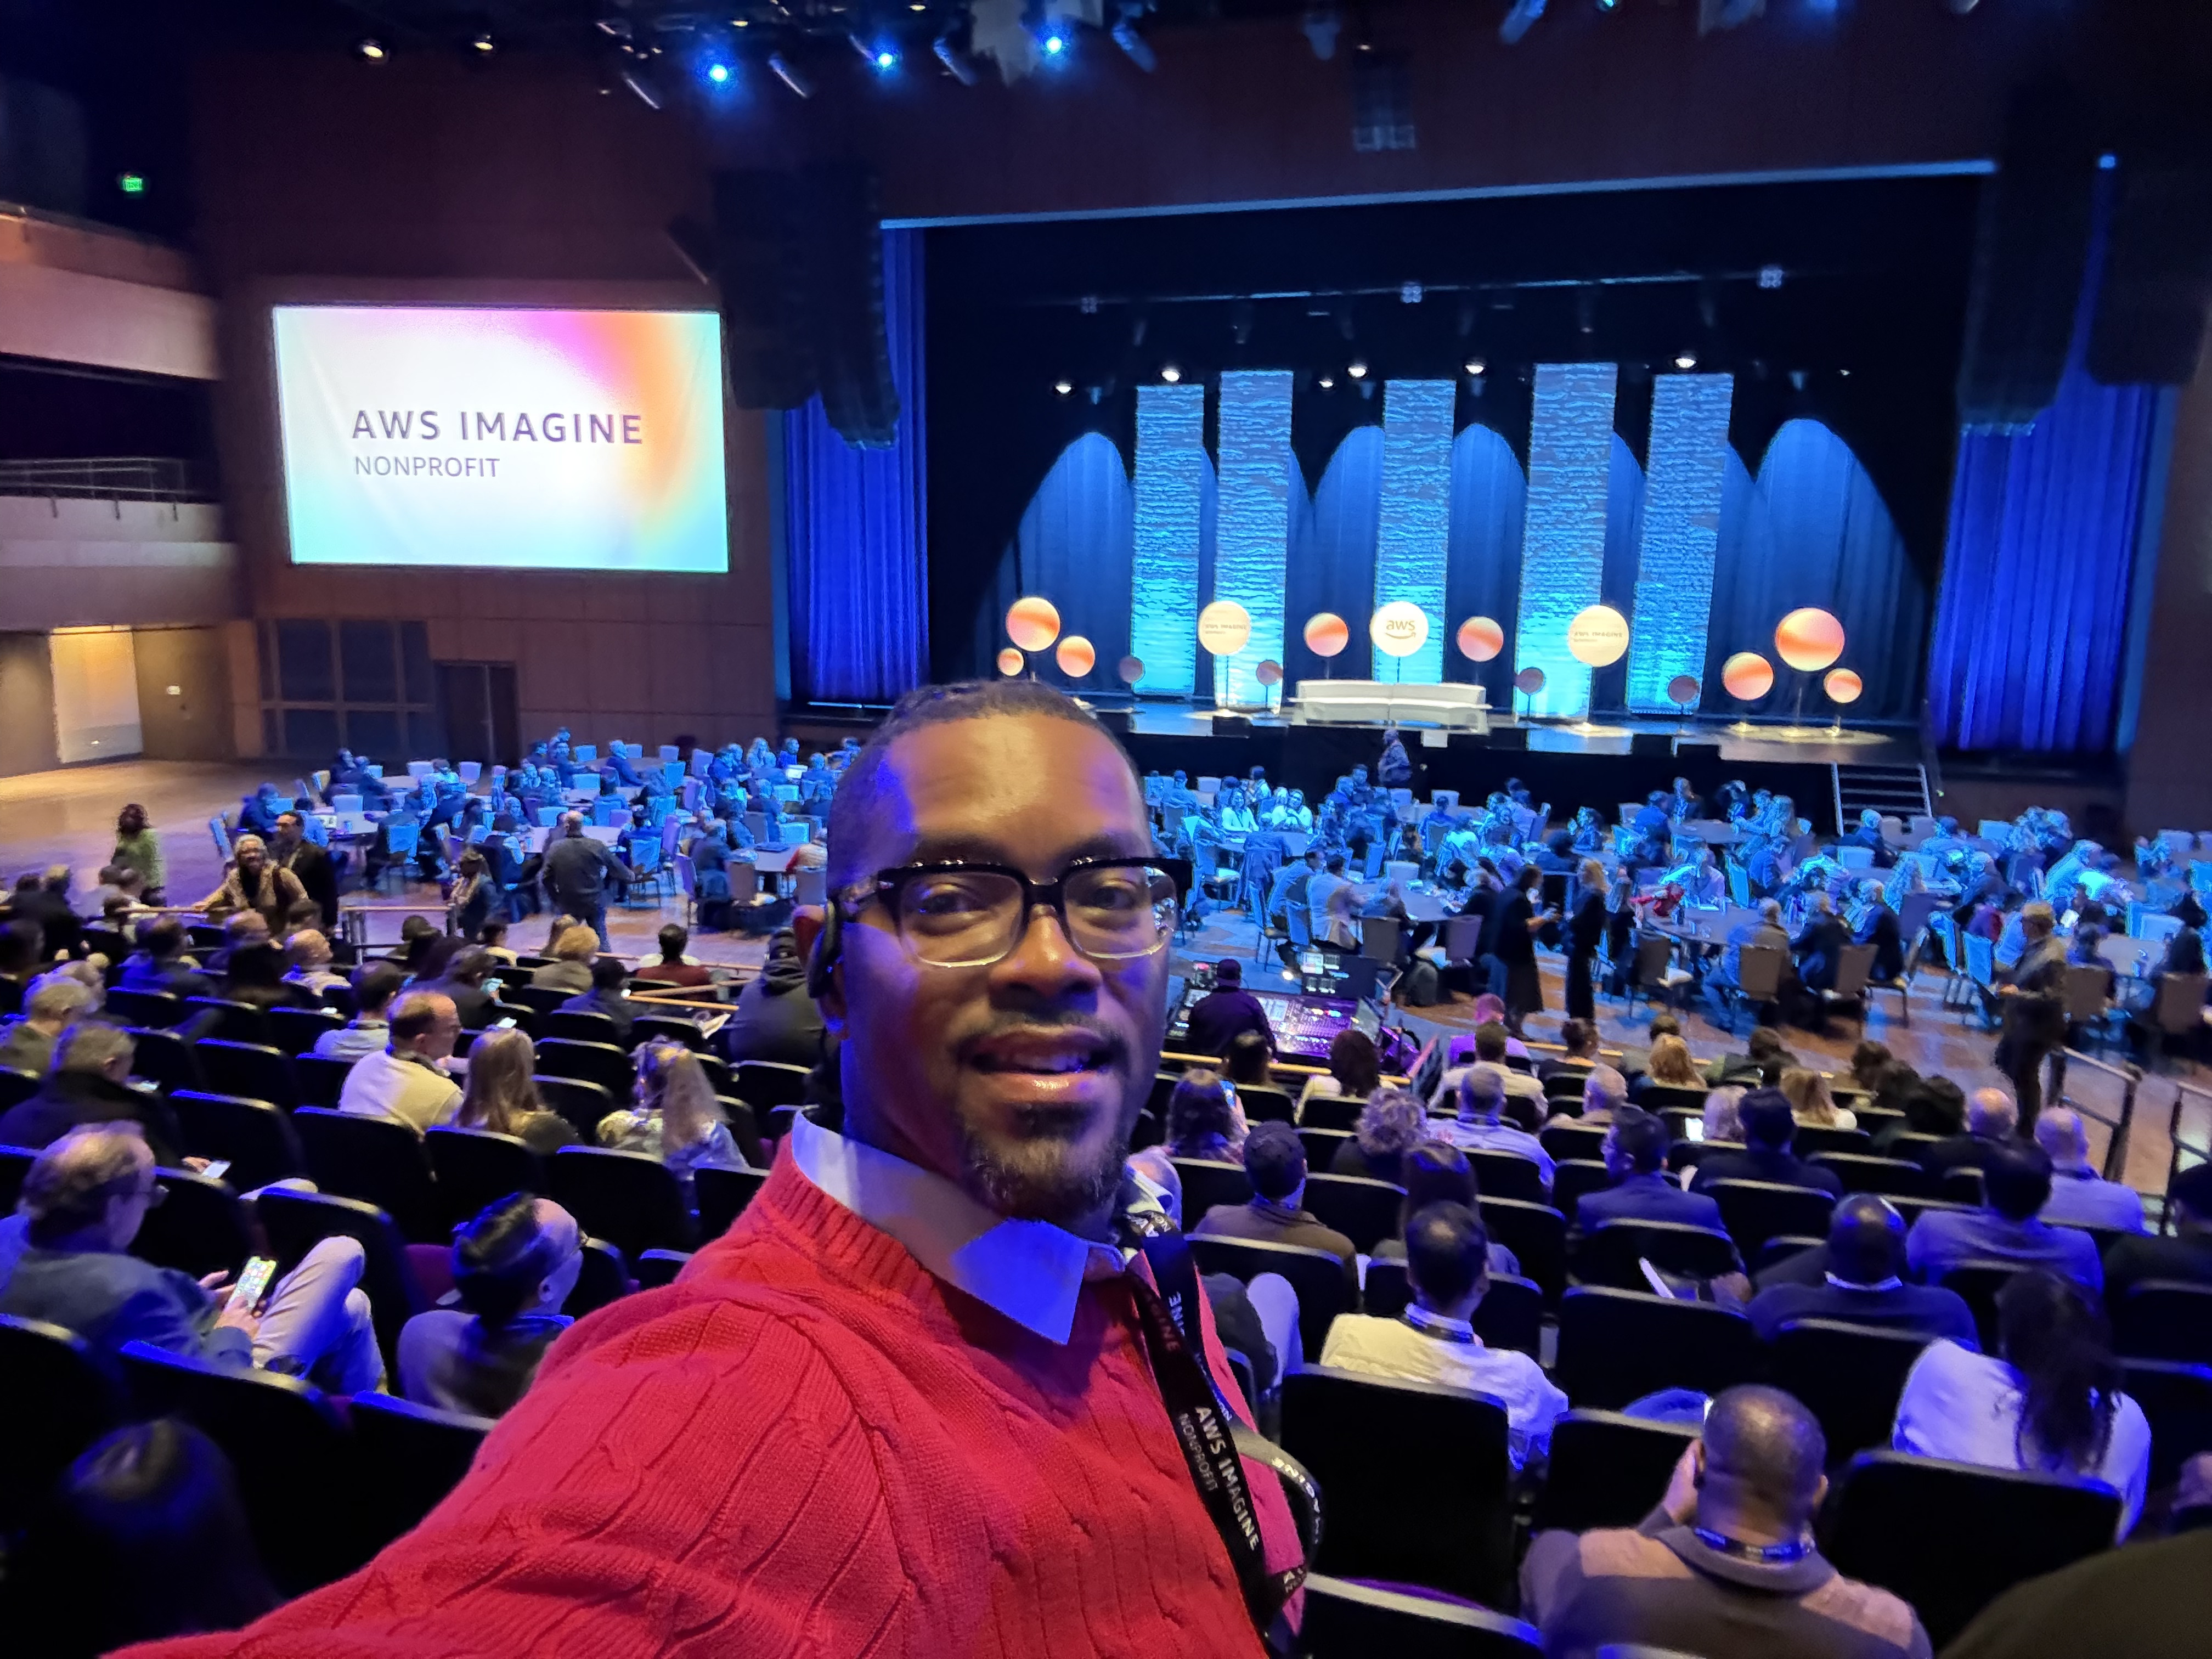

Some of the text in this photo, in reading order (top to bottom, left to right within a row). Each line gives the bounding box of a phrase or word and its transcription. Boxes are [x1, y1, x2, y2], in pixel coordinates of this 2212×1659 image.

[352, 410, 643, 445] AWS IMAGINE
[354, 456, 500, 478] NONPROFIT
[1386, 620, 1415, 631] aws
[1179, 1412, 1218, 1491] NONPROFIT
[1195, 1406, 1227, 1454] AWS
[1218, 1457, 1260, 1551] IMAGINE
